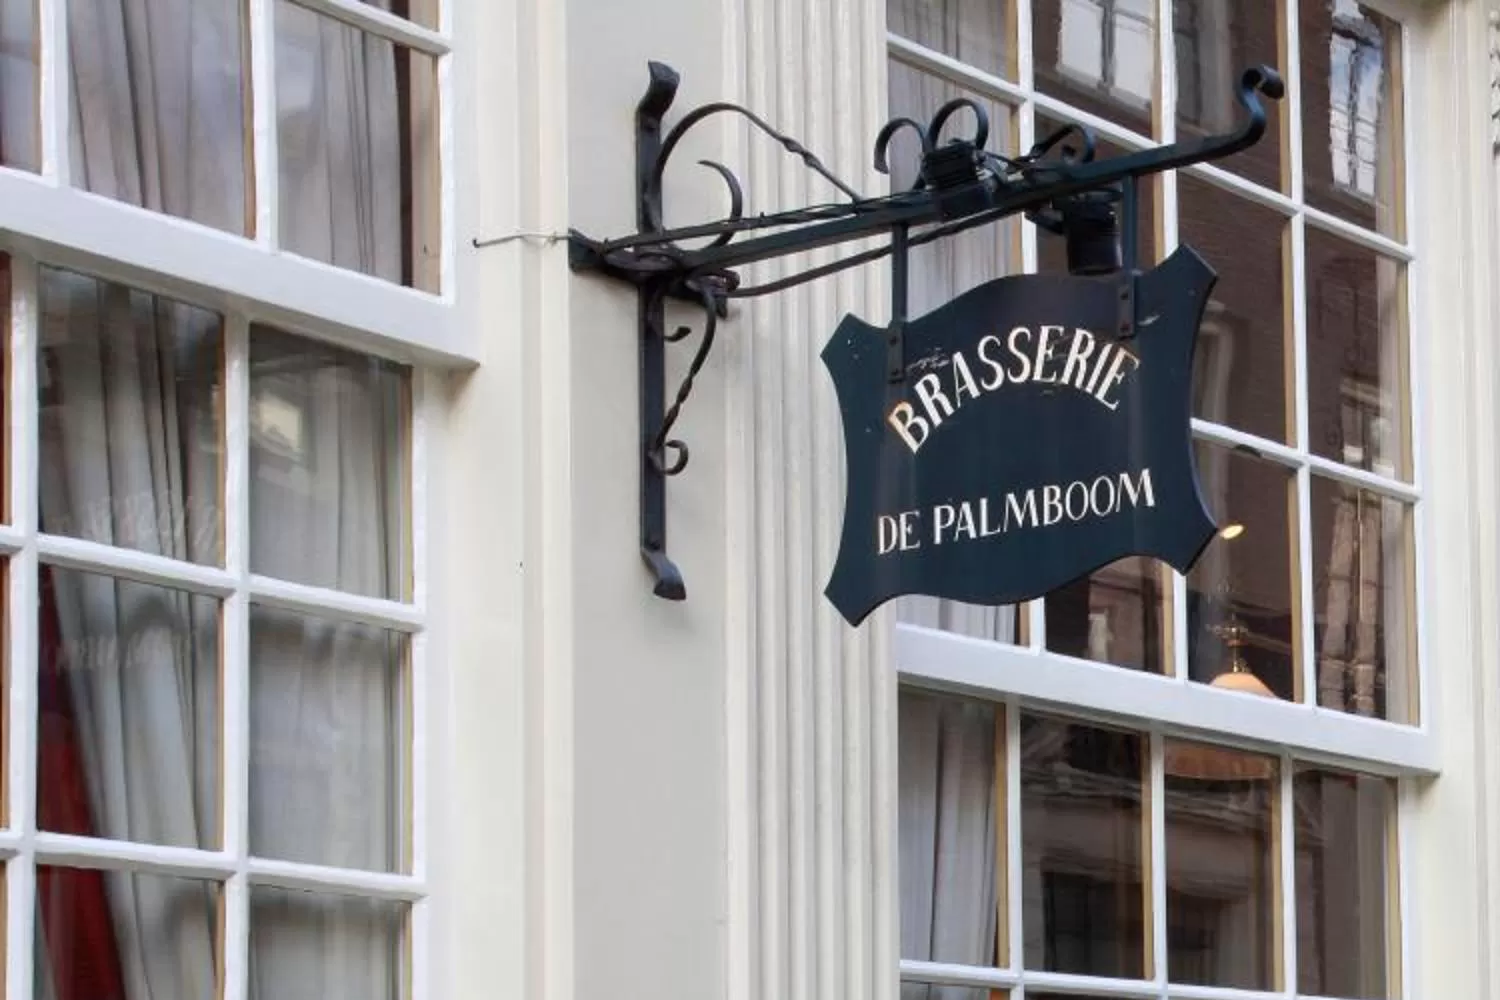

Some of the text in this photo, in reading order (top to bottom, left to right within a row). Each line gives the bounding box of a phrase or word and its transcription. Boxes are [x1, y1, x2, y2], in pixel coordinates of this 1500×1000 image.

[887, 324, 1141, 455] BRASSERIE
[877, 468, 1156, 556] DE PALMBOOM
